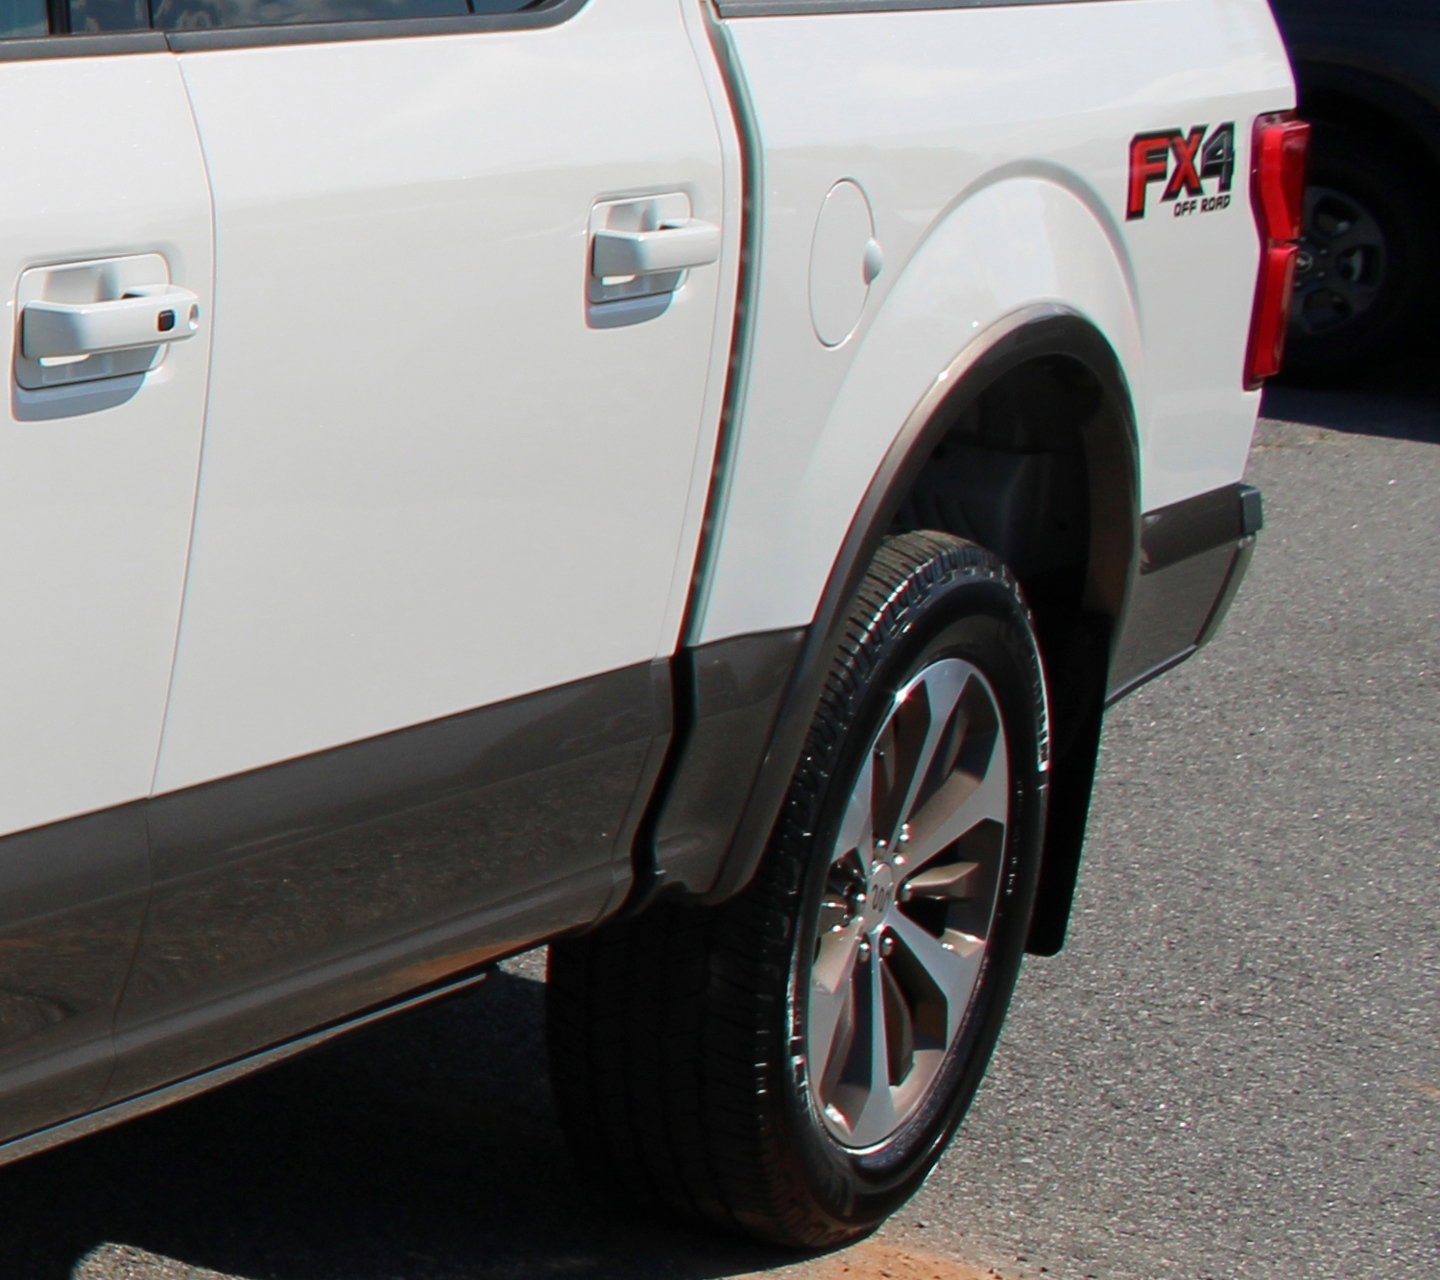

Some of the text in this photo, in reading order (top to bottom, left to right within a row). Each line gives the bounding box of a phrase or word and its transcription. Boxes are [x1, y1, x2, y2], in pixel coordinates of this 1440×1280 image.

[1125, 121, 1236, 222] FX4
[1174, 195, 1231, 217] OFF ROAD
